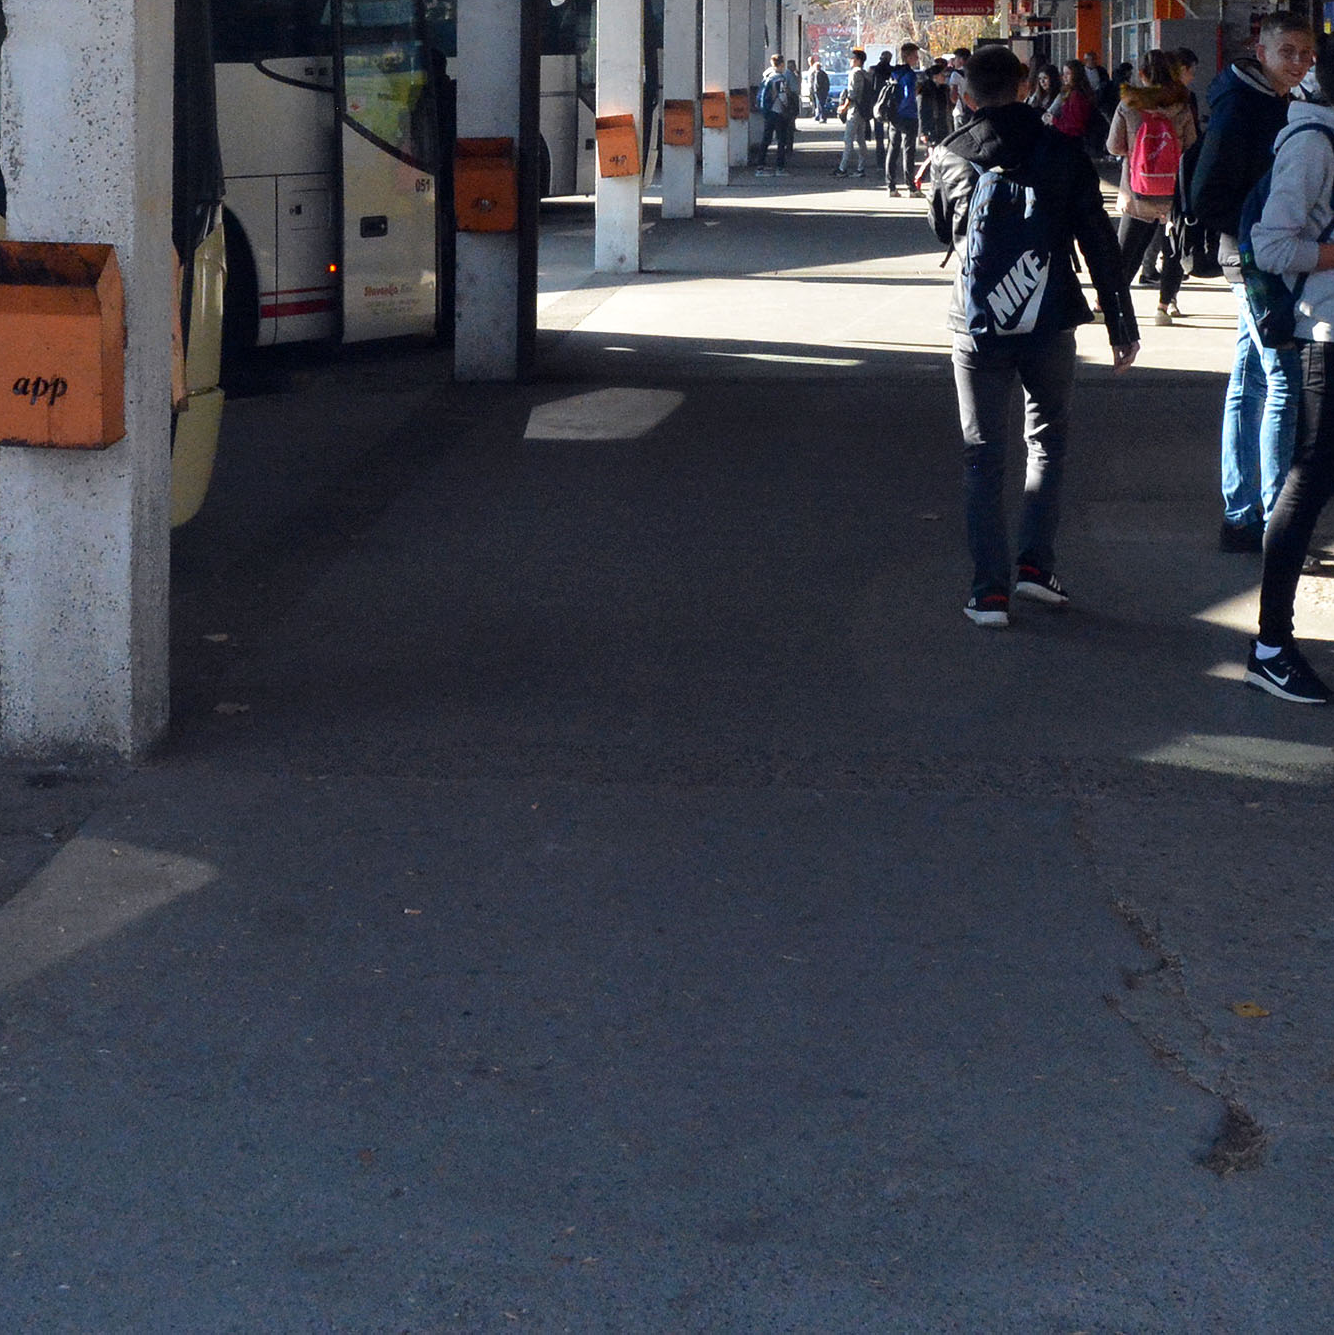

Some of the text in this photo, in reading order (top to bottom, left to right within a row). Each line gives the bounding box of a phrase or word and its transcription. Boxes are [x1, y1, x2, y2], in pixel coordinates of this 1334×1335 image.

[916, 5, 932, 14] WC
[415, 178, 431, 192] 051
[987, 249, 1046, 326] NIKE
[12, 376, 68, 406] app
